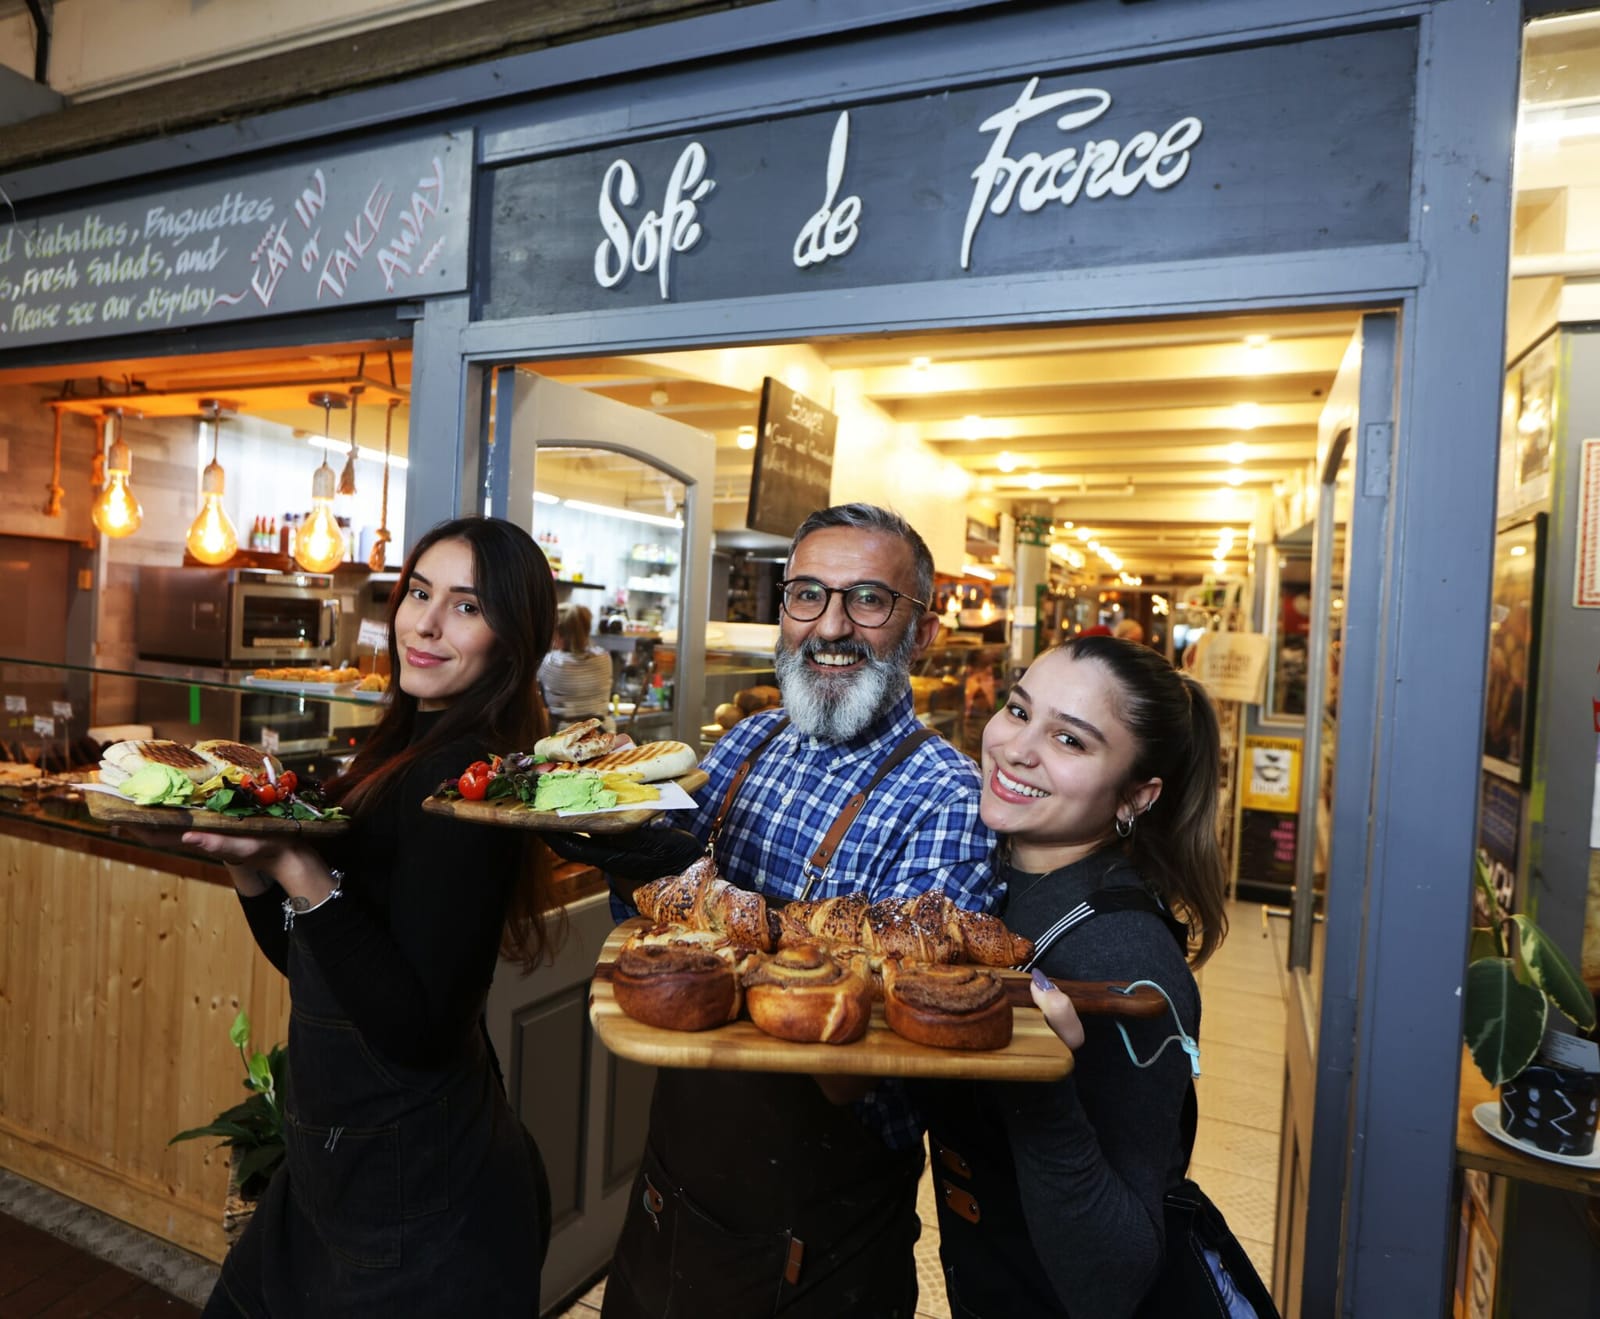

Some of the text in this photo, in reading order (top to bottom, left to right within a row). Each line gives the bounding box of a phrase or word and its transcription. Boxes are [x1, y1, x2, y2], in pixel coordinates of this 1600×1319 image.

[143, 191, 275, 247] Baguettes
[376, 156, 446, 293] AWAY
[794, 110, 862, 268] de
[960, 76, 1203, 269] France
[22, 257, 79, 296] Fresh
[87, 242, 172, 287] Salads,
[175, 235, 228, 276] and
[251, 168, 327, 308] EAT IN
[317, 178, 394, 300] TAKE
[11, 282, 215, 333] Please see our display
